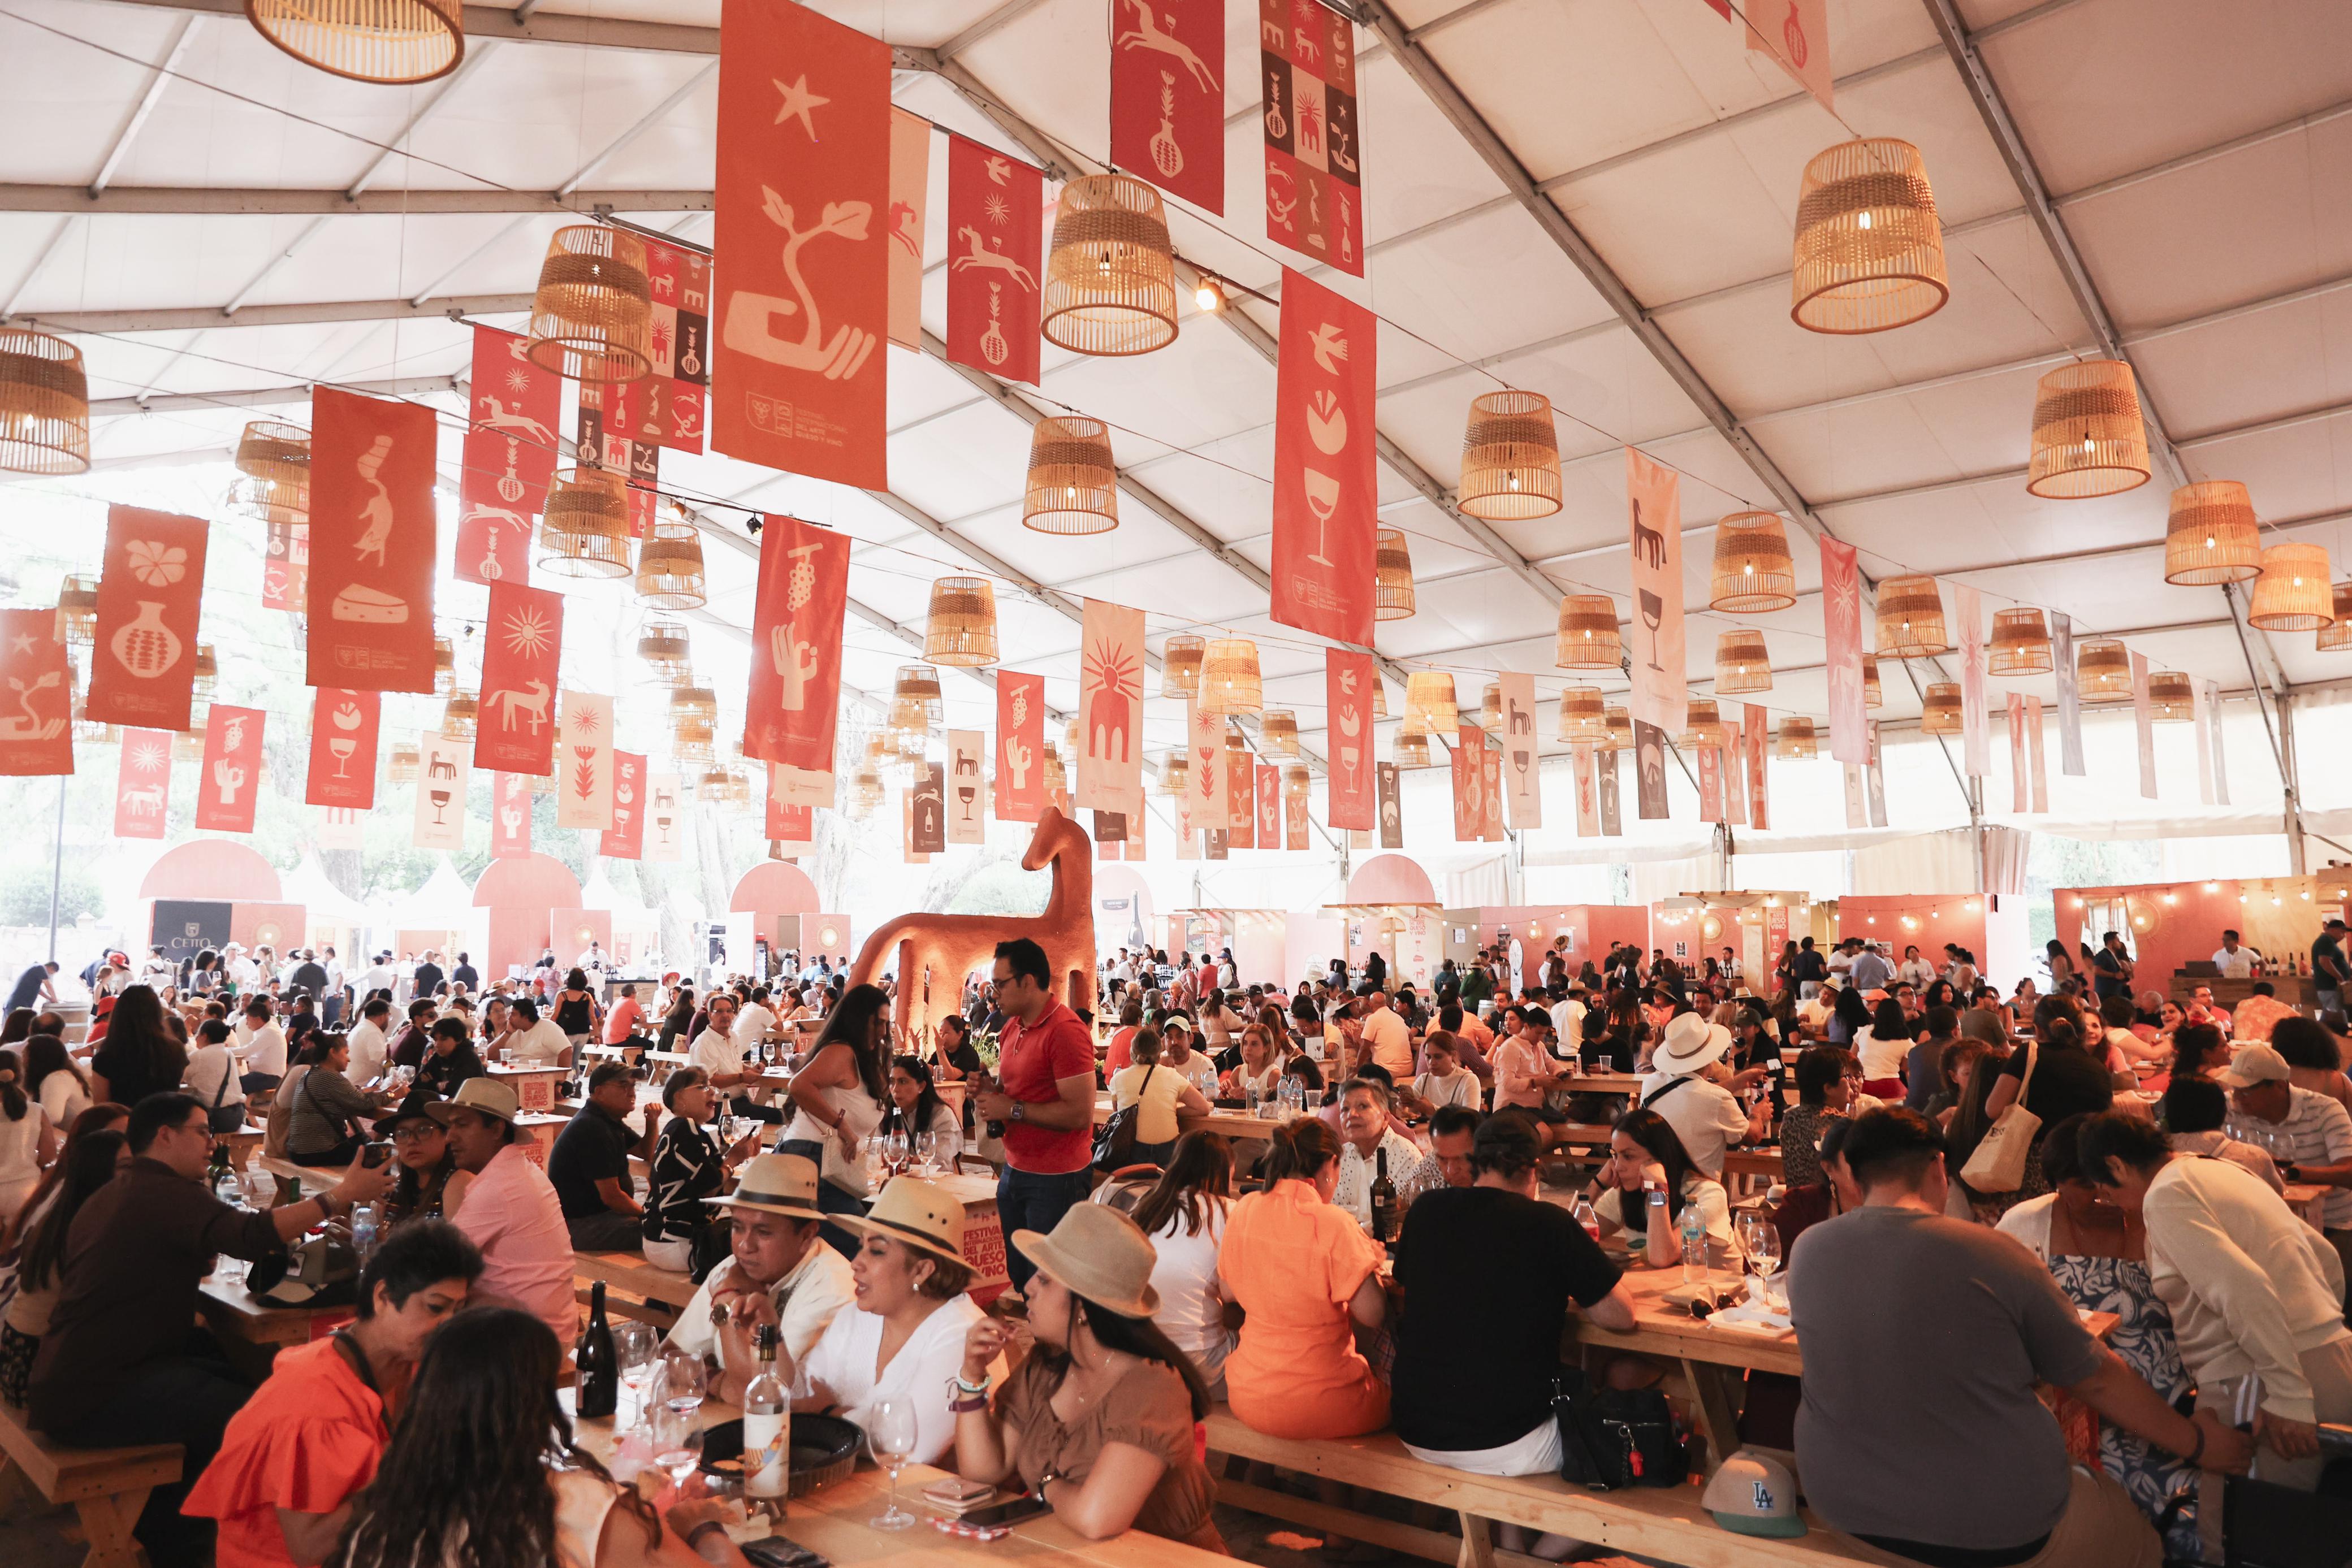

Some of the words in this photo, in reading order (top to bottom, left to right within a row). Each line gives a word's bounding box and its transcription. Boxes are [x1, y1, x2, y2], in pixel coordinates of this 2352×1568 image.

[795, 431, 819, 441] QUESO
[827, 438, 843, 447] VINO
[171, 937, 211, 948] CETTO
[964, 1225, 1001, 1240] FESTIVA
[964, 1246, 978, 1256] DEL
[965, 1250, 1005, 1267] QUESO
[1753, 1481, 1774, 1510] LA
